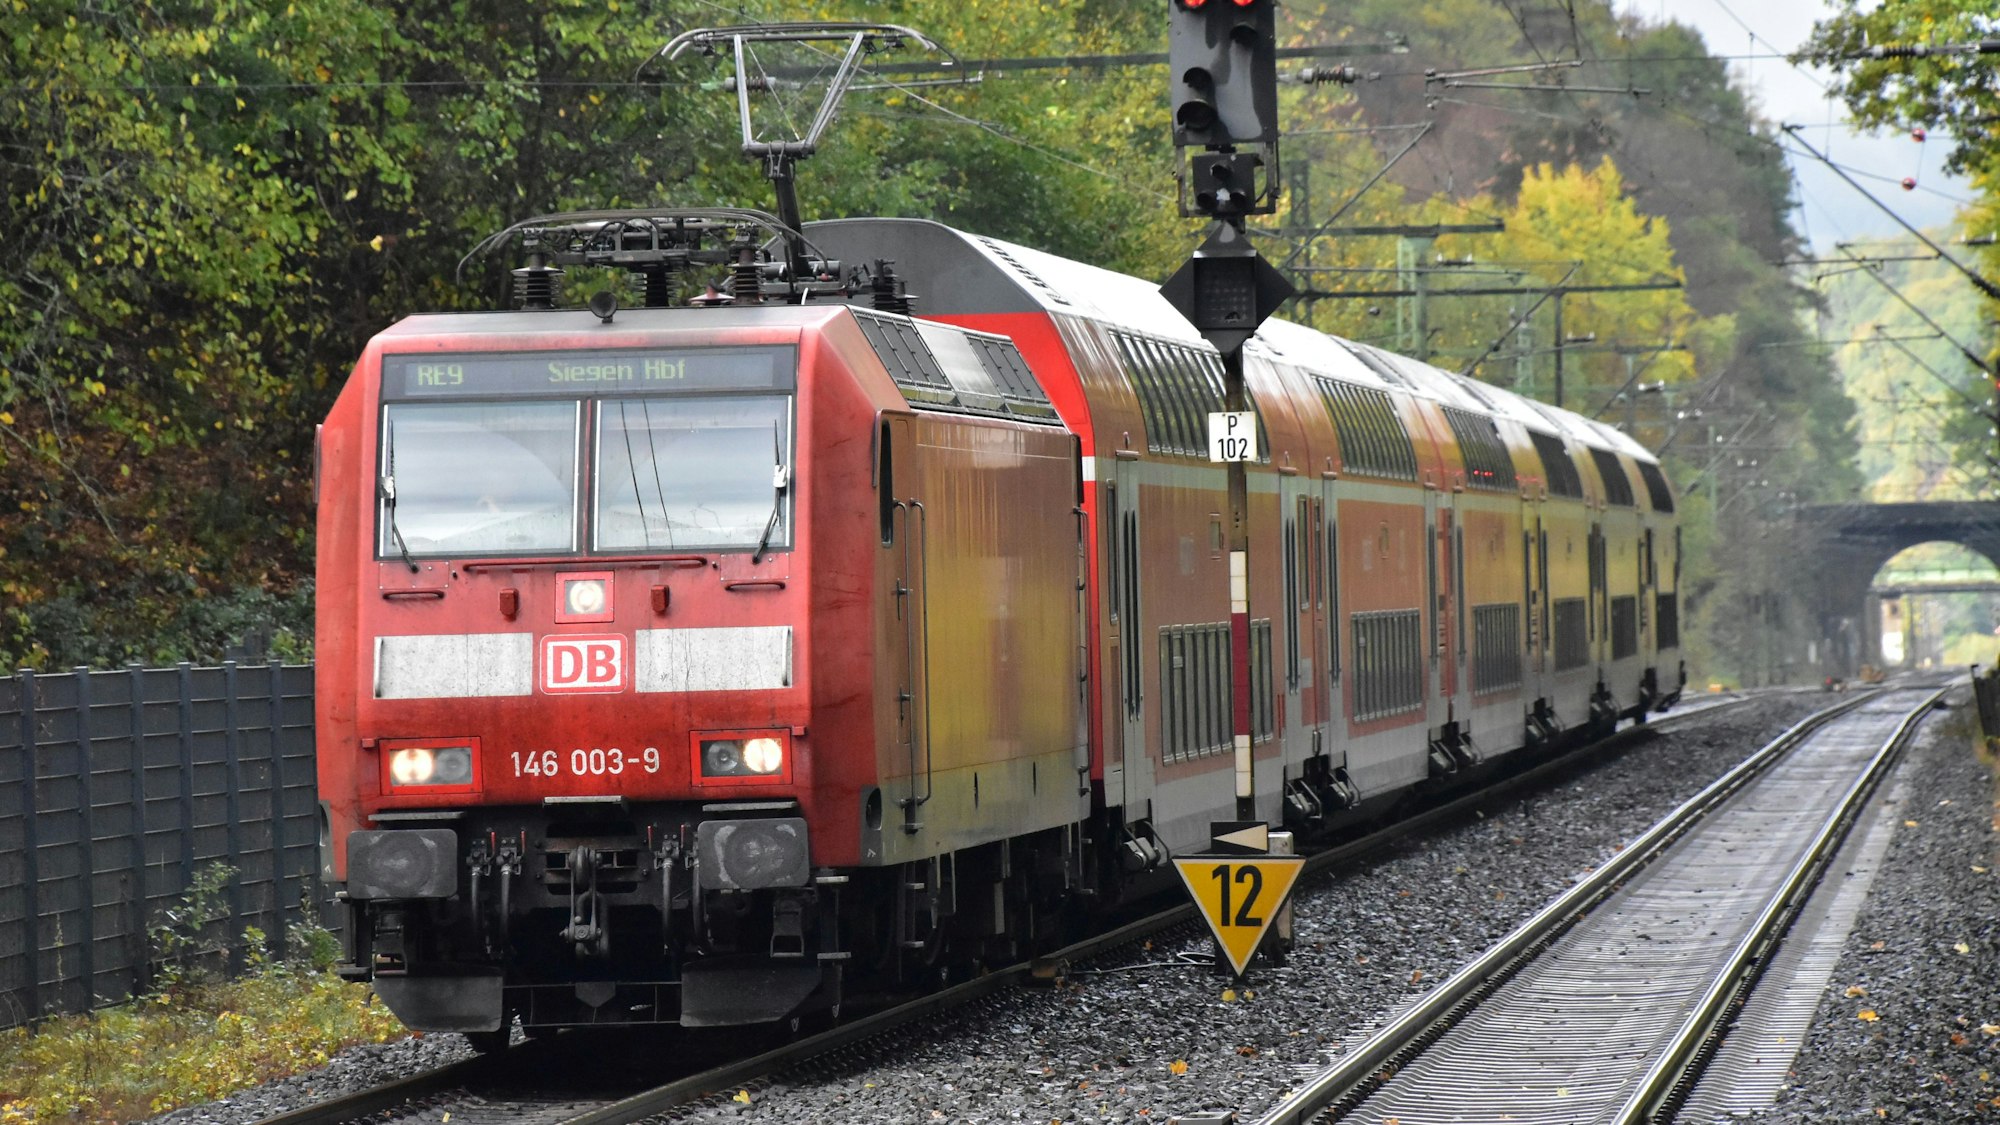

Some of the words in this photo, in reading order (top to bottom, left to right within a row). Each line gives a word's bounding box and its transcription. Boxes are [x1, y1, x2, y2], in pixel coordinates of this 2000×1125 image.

[417, 364, 464, 386] RE9
[547, 361, 633, 383] Siegen
[644, 358, 686, 380] Hbf
[1227, 415, 1238, 436] P
[1217, 437, 1248, 460] 102
[552, 644, 617, 684] DB
[510, 750, 559, 777] 146
[570, 747, 660, 776] 003-9
[1212, 864, 1263, 927] 12
